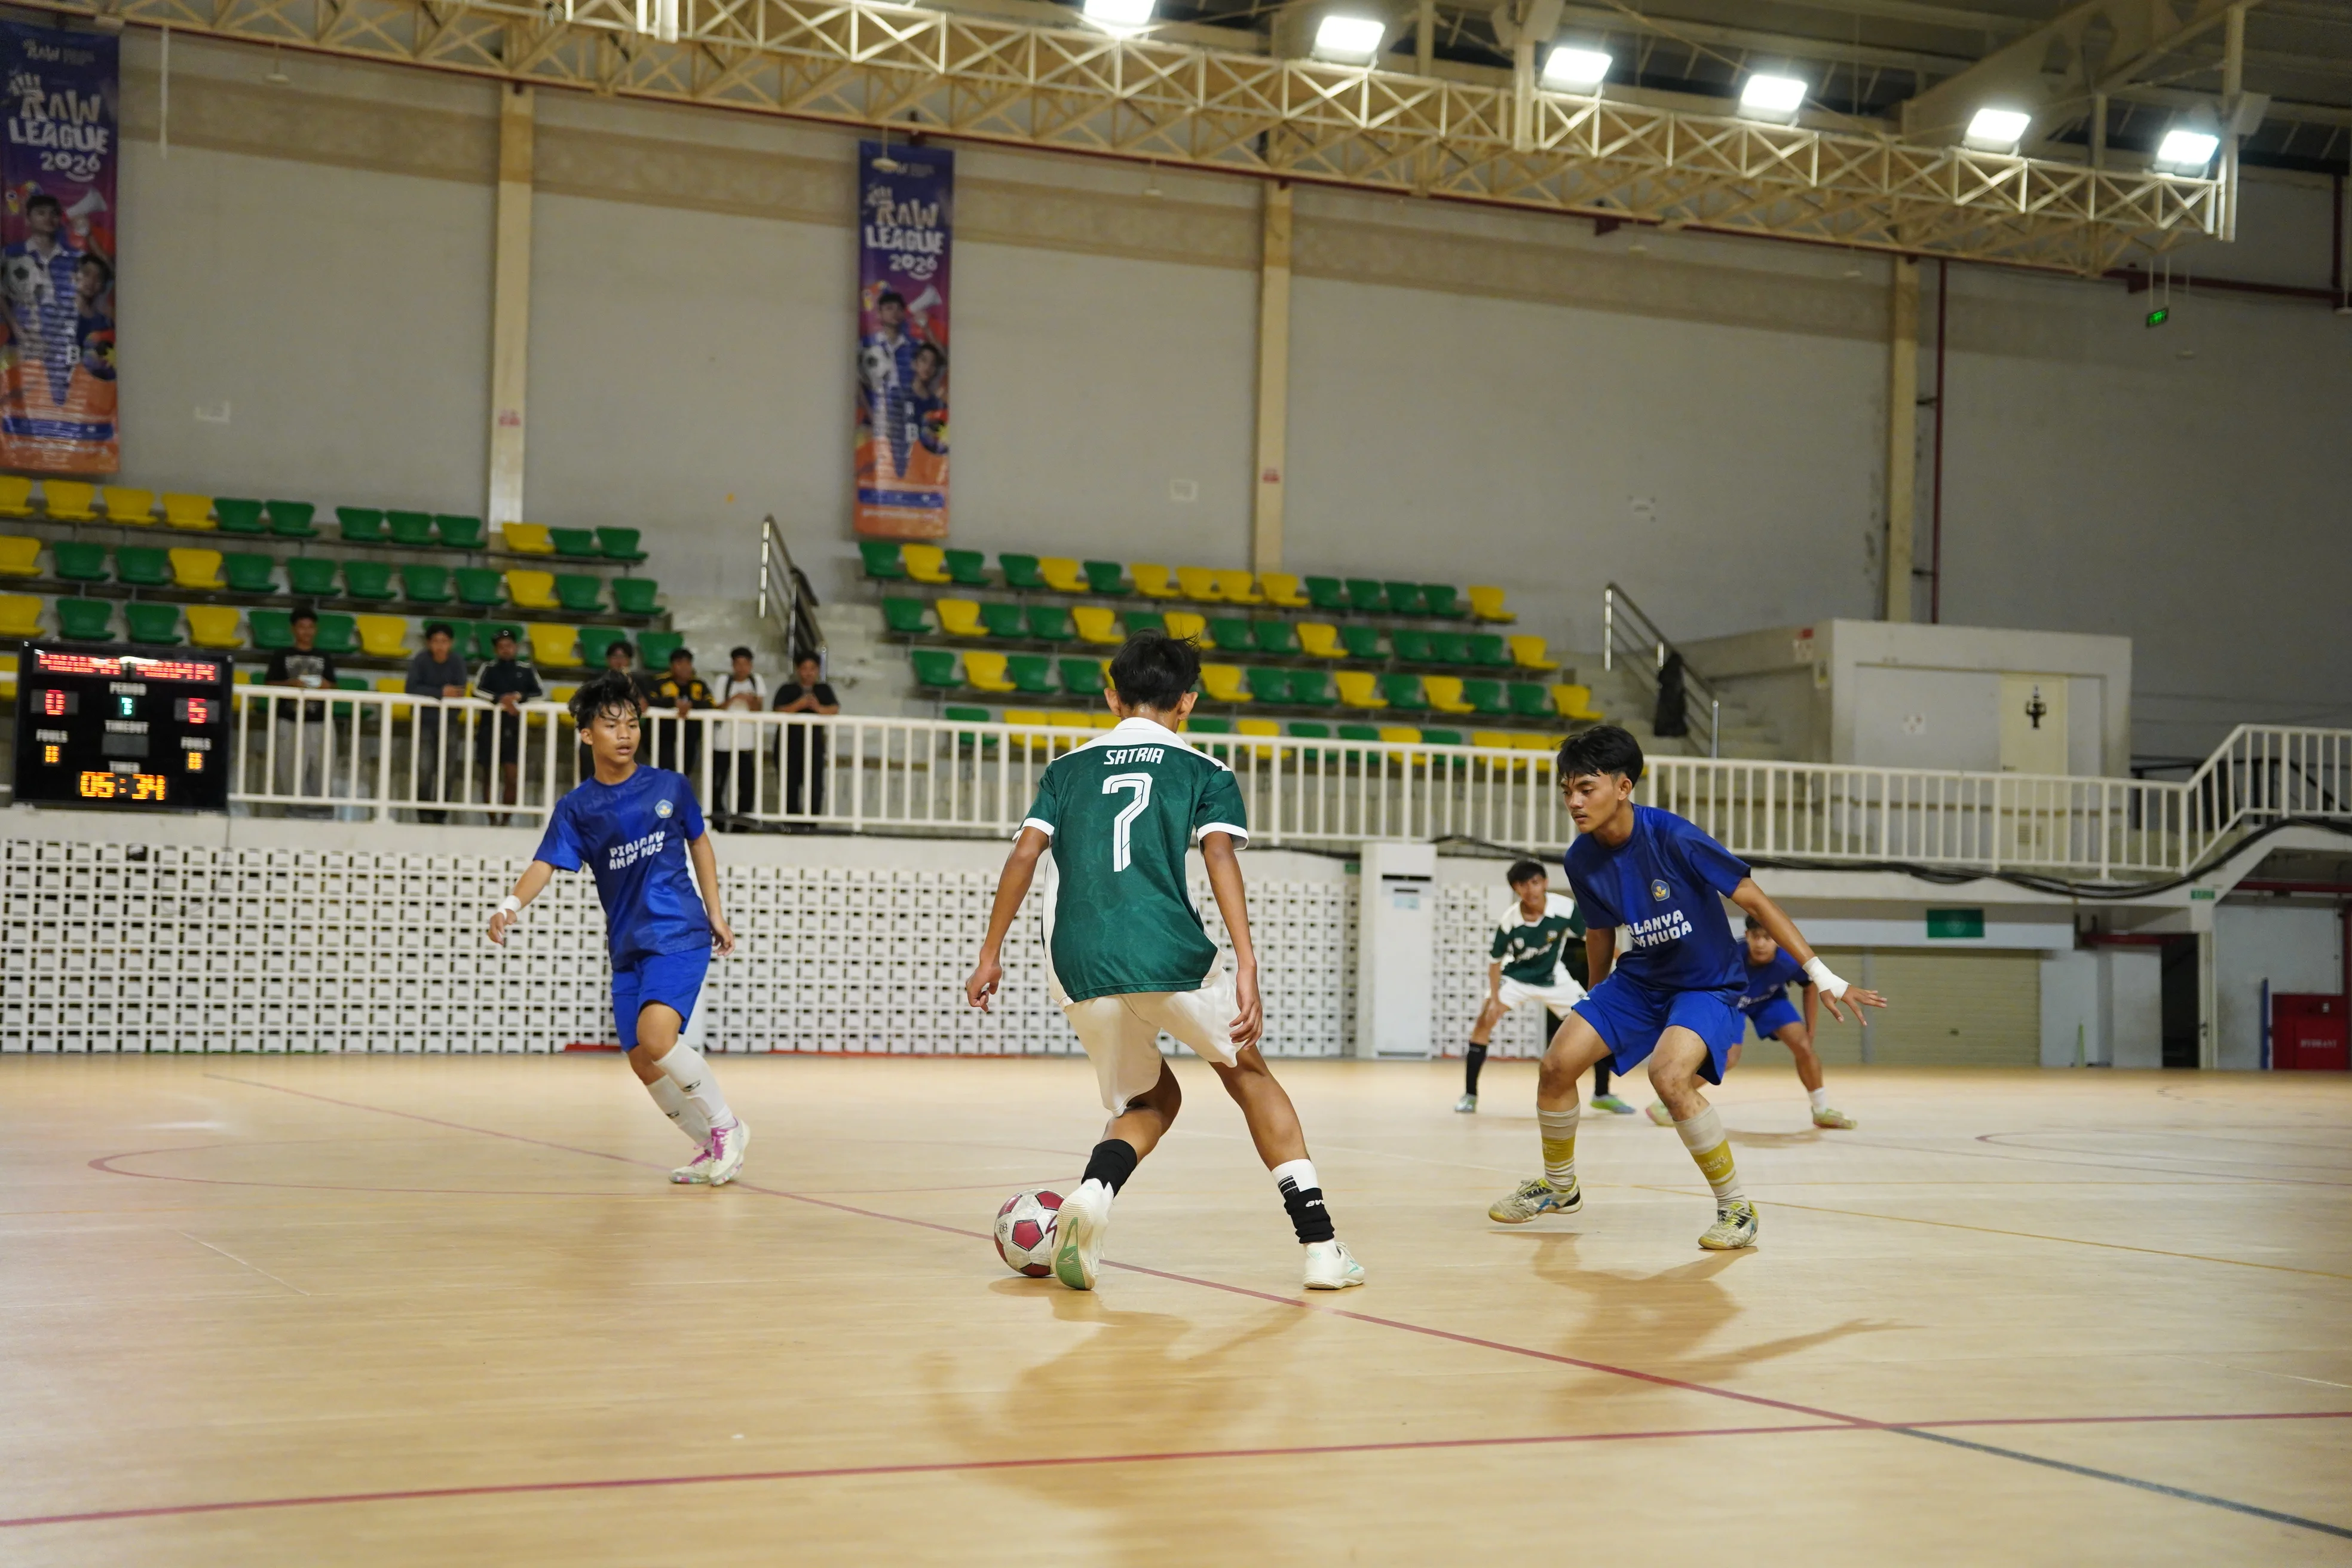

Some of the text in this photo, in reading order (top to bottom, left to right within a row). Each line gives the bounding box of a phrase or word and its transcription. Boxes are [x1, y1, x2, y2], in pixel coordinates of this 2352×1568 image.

[17, 81, 101, 125] RAW
[8, 116, 109, 155] LEAGUE
[39, 151, 101, 175] 2026
[872, 192, 939, 230] RAW
[864, 224, 945, 255] LEAGUE
[888, 253, 938, 274] 2026
[1104, 748, 1165, 765] SATRIA
[80, 771, 166, 801] 05:34
[1102, 773, 1153, 872] 7
[1647, 921, 1692, 946] MUDA
